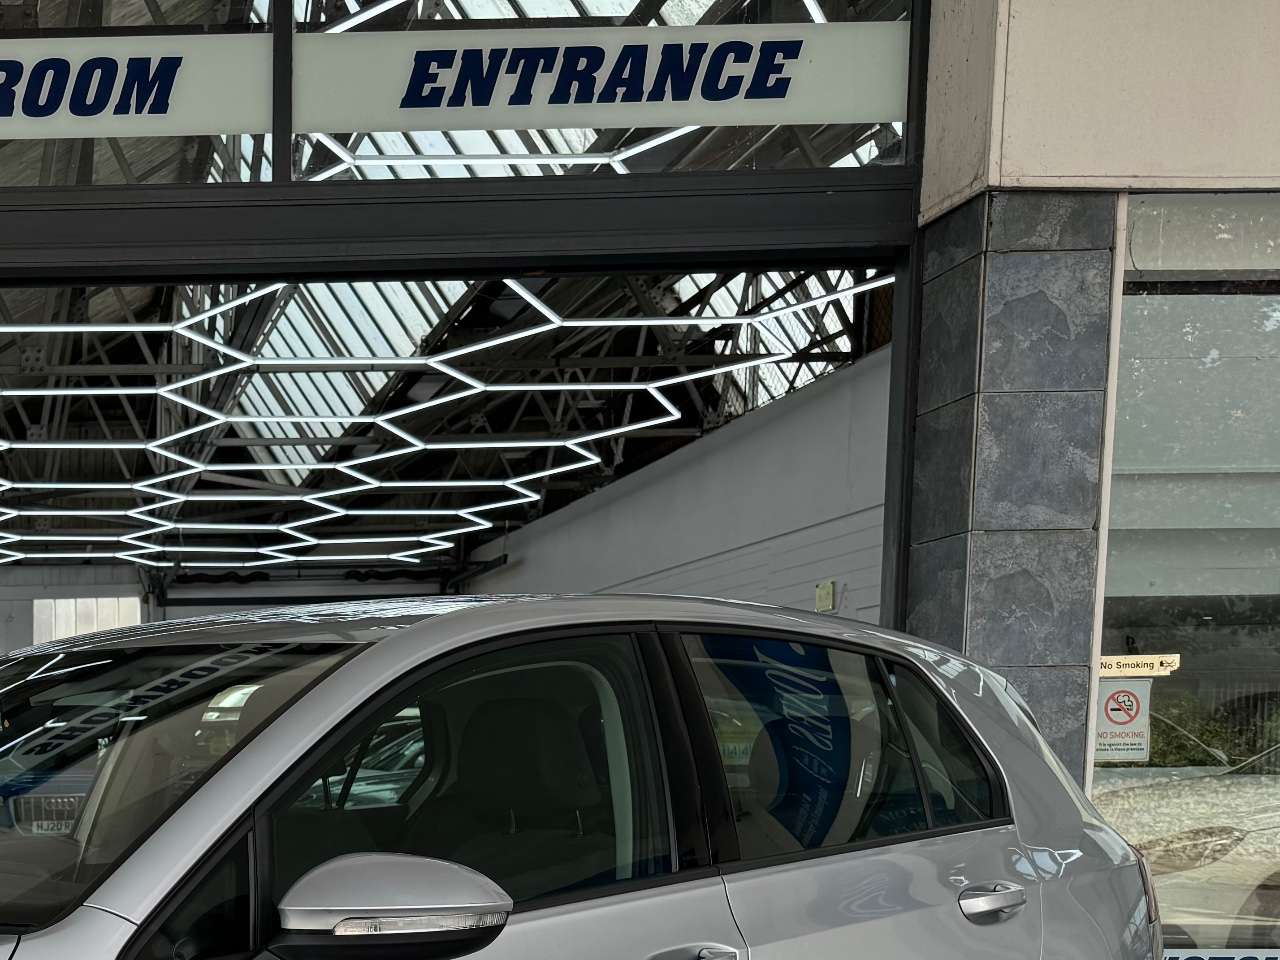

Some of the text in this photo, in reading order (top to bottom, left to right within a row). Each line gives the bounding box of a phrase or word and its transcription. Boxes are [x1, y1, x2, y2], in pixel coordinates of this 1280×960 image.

[399, 39, 804, 109] ENTRANCE
[1100, 660, 1155, 670] No Smoking
[1097, 731, 1145, 739] NO SMOKING
